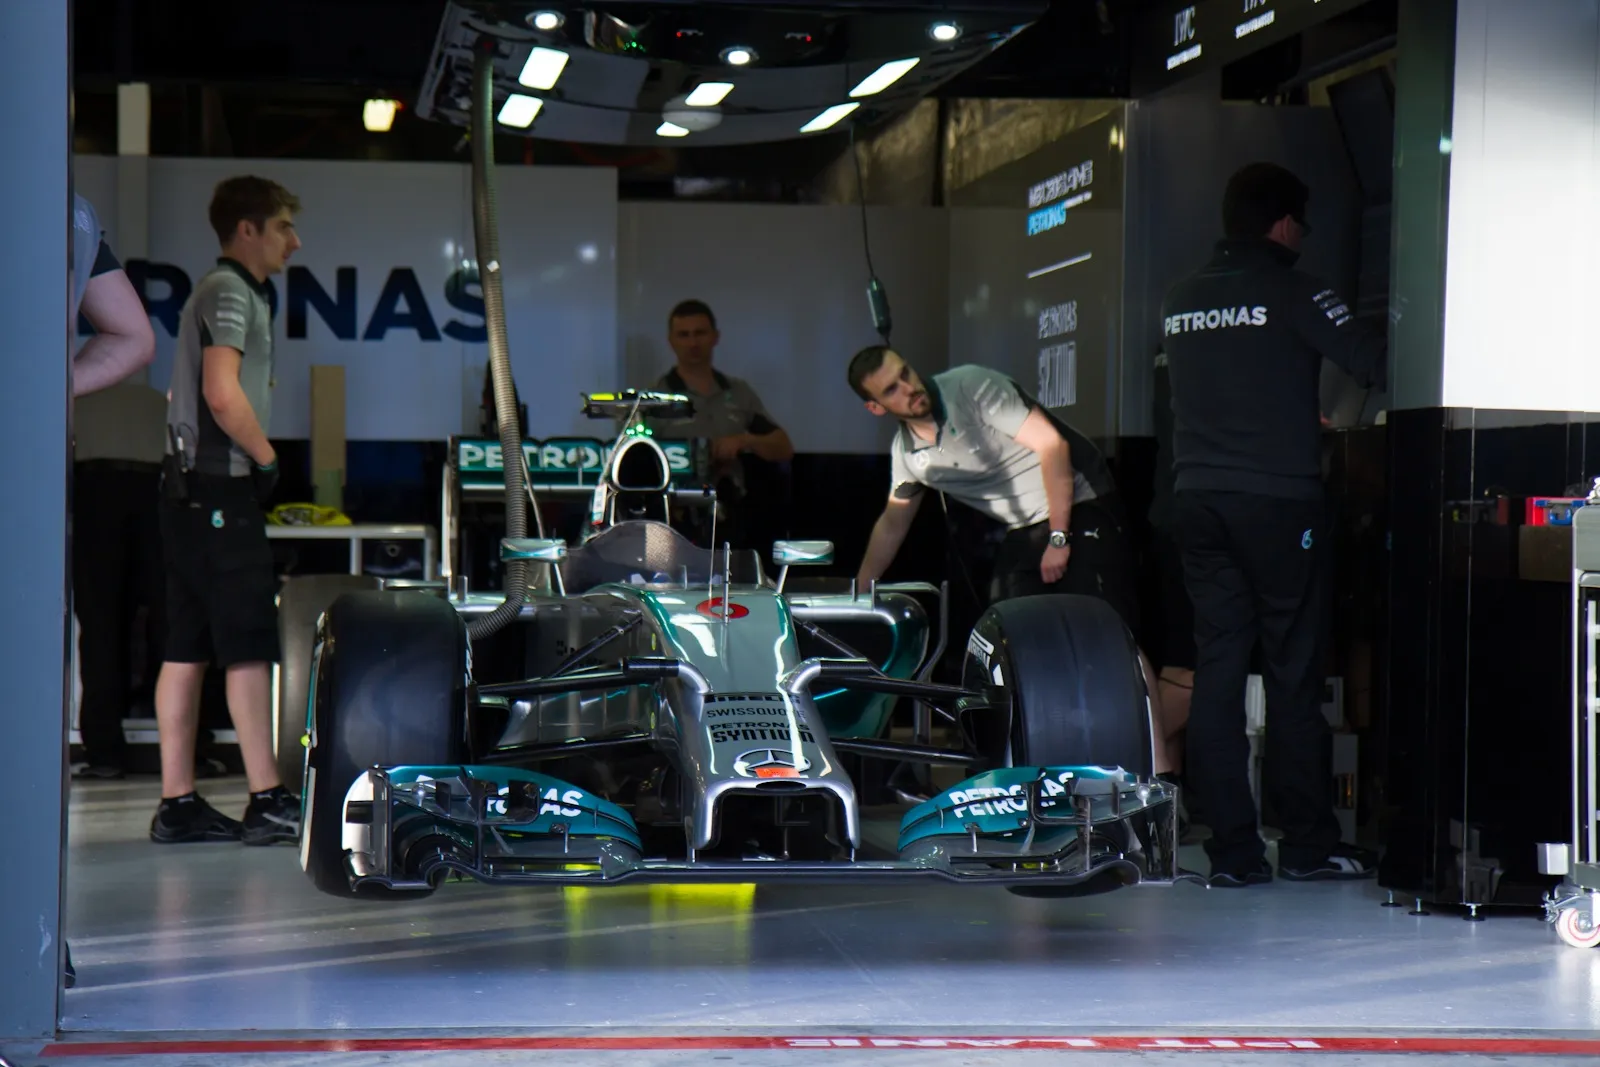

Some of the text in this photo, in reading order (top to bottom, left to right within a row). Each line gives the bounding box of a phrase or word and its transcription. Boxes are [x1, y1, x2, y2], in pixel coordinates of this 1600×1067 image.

[1174, 6, 1196, 46] IWC
[1164, 306, 1268, 337] PETRONAS
[459, 443, 690, 470] PETROS
[696, 596, 749, 619] 6
[706, 706, 806, 719] SWISSQUOE
